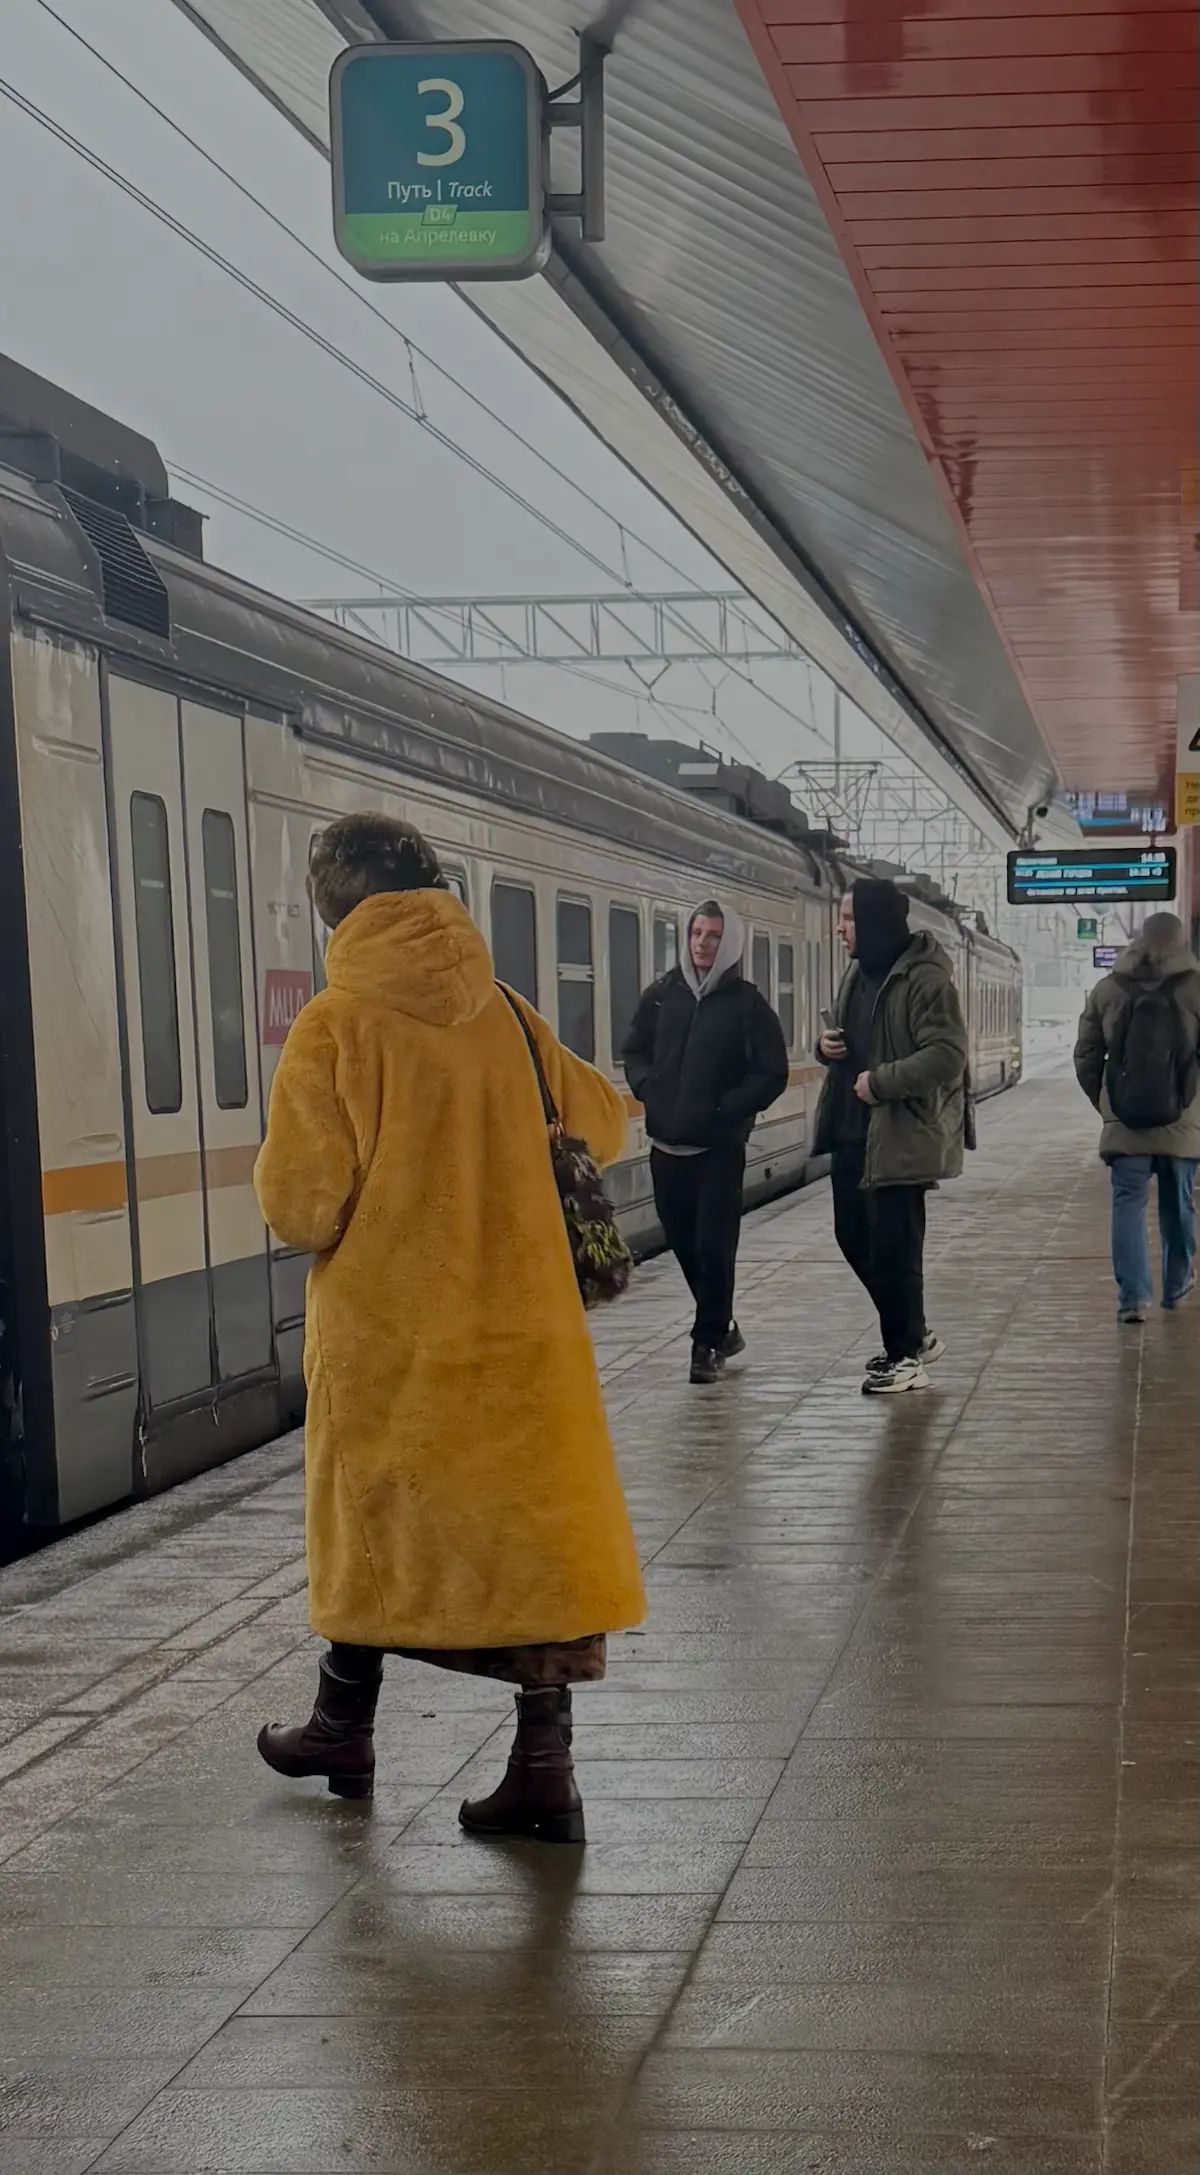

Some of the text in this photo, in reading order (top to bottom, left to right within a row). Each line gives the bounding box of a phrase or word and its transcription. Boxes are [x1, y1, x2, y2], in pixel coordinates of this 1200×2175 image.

[416, 77, 467, 167] 3
[387, 180, 432, 204] Путь
[447, 180, 493, 199] Track
[429, 207, 451, 221] D4
[379, 228, 497, 247] на Апрелевку
